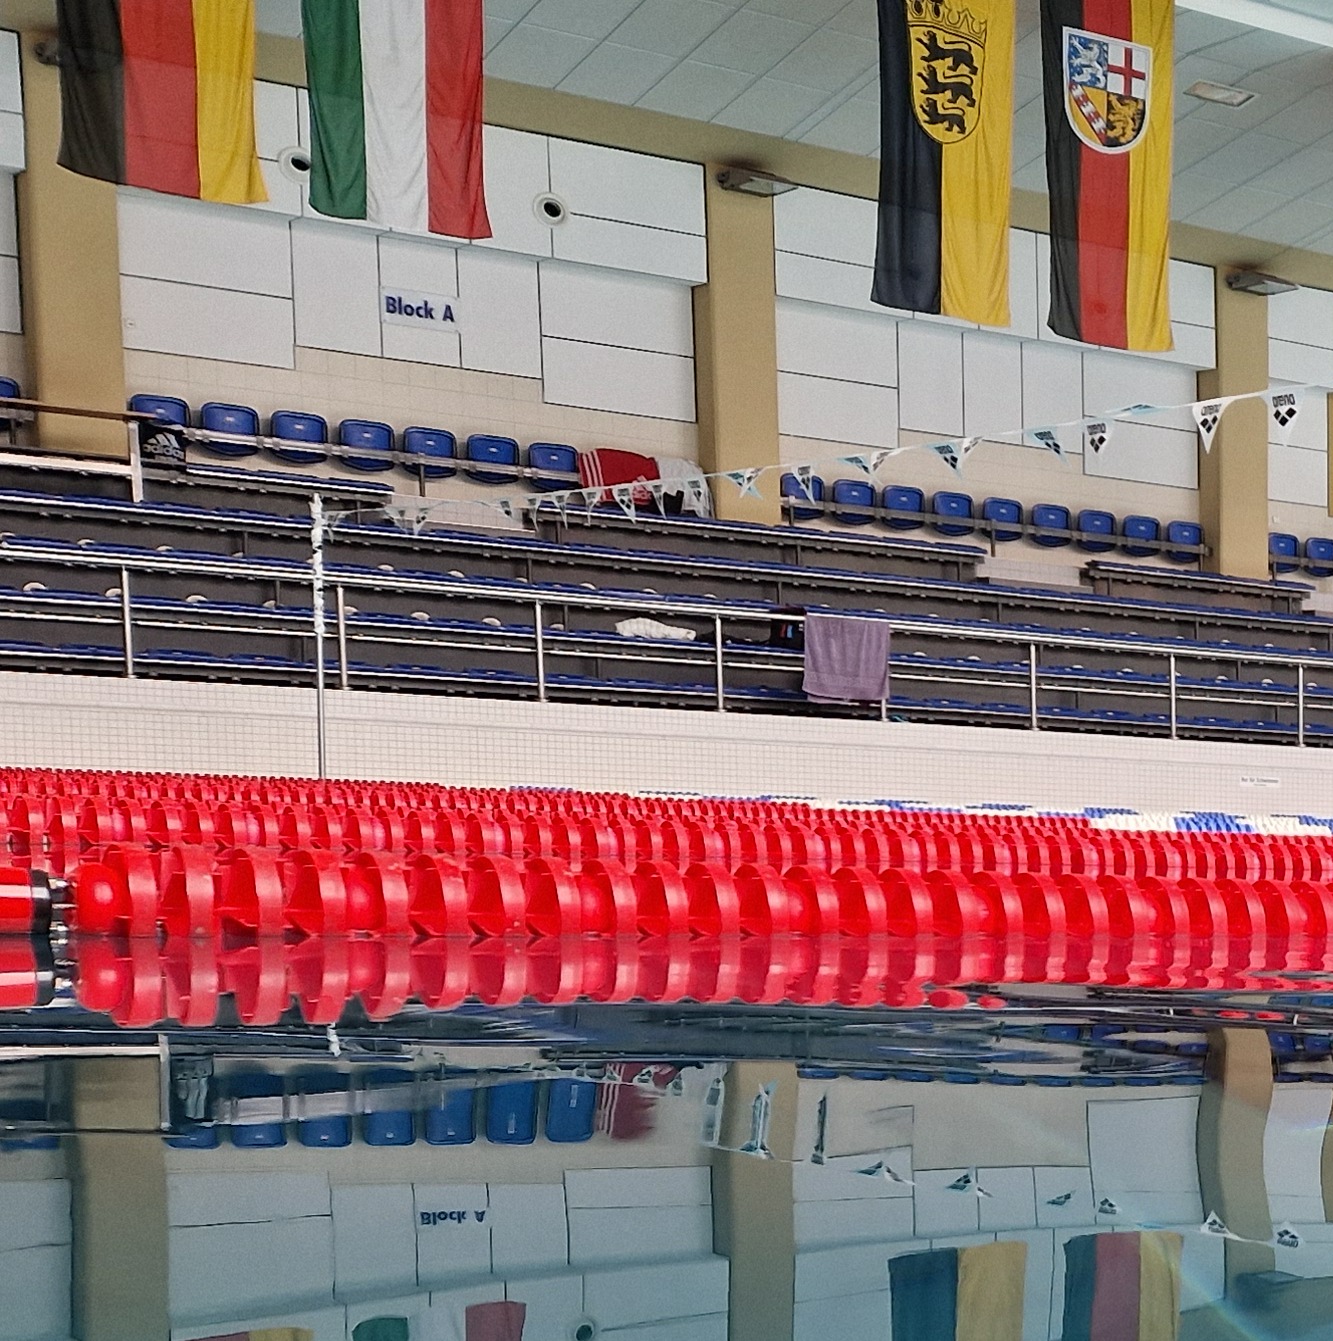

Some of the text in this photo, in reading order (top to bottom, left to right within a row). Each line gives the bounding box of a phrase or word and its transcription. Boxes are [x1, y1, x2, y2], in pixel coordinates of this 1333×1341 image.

[385, 295, 455, 323] Block A
[142, 443, 186, 460] adidas
